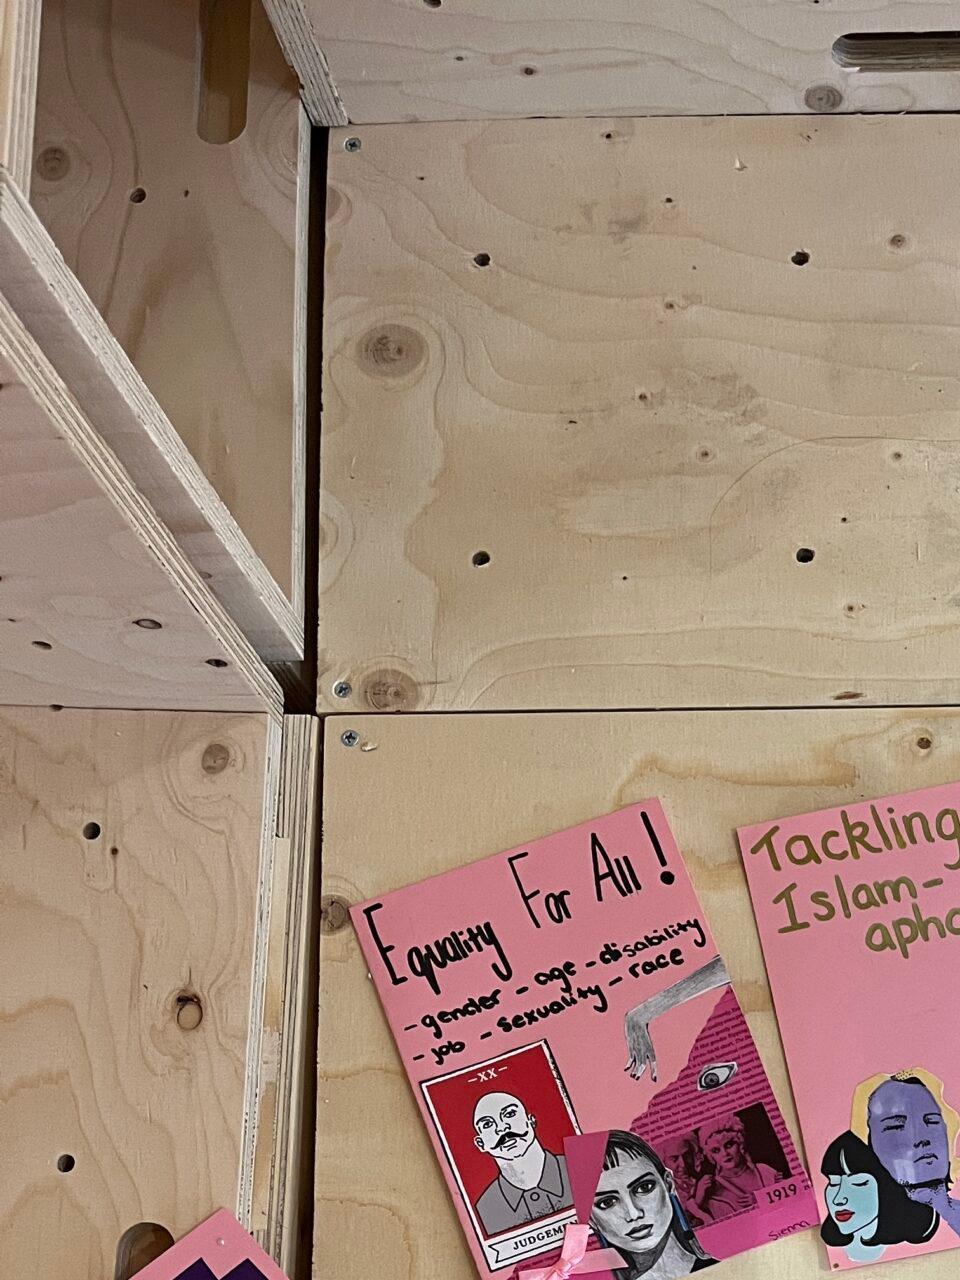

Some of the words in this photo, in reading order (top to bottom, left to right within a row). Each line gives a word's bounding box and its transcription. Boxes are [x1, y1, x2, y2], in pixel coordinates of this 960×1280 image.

[508, 851, 572, 929] For
[773, 874, 944, 934] Islam-
[363, 903, 512, 995] Equality
[765, 1183, 798, 1204] 1919
[513, 1219, 578, 1250] JUDGEM
